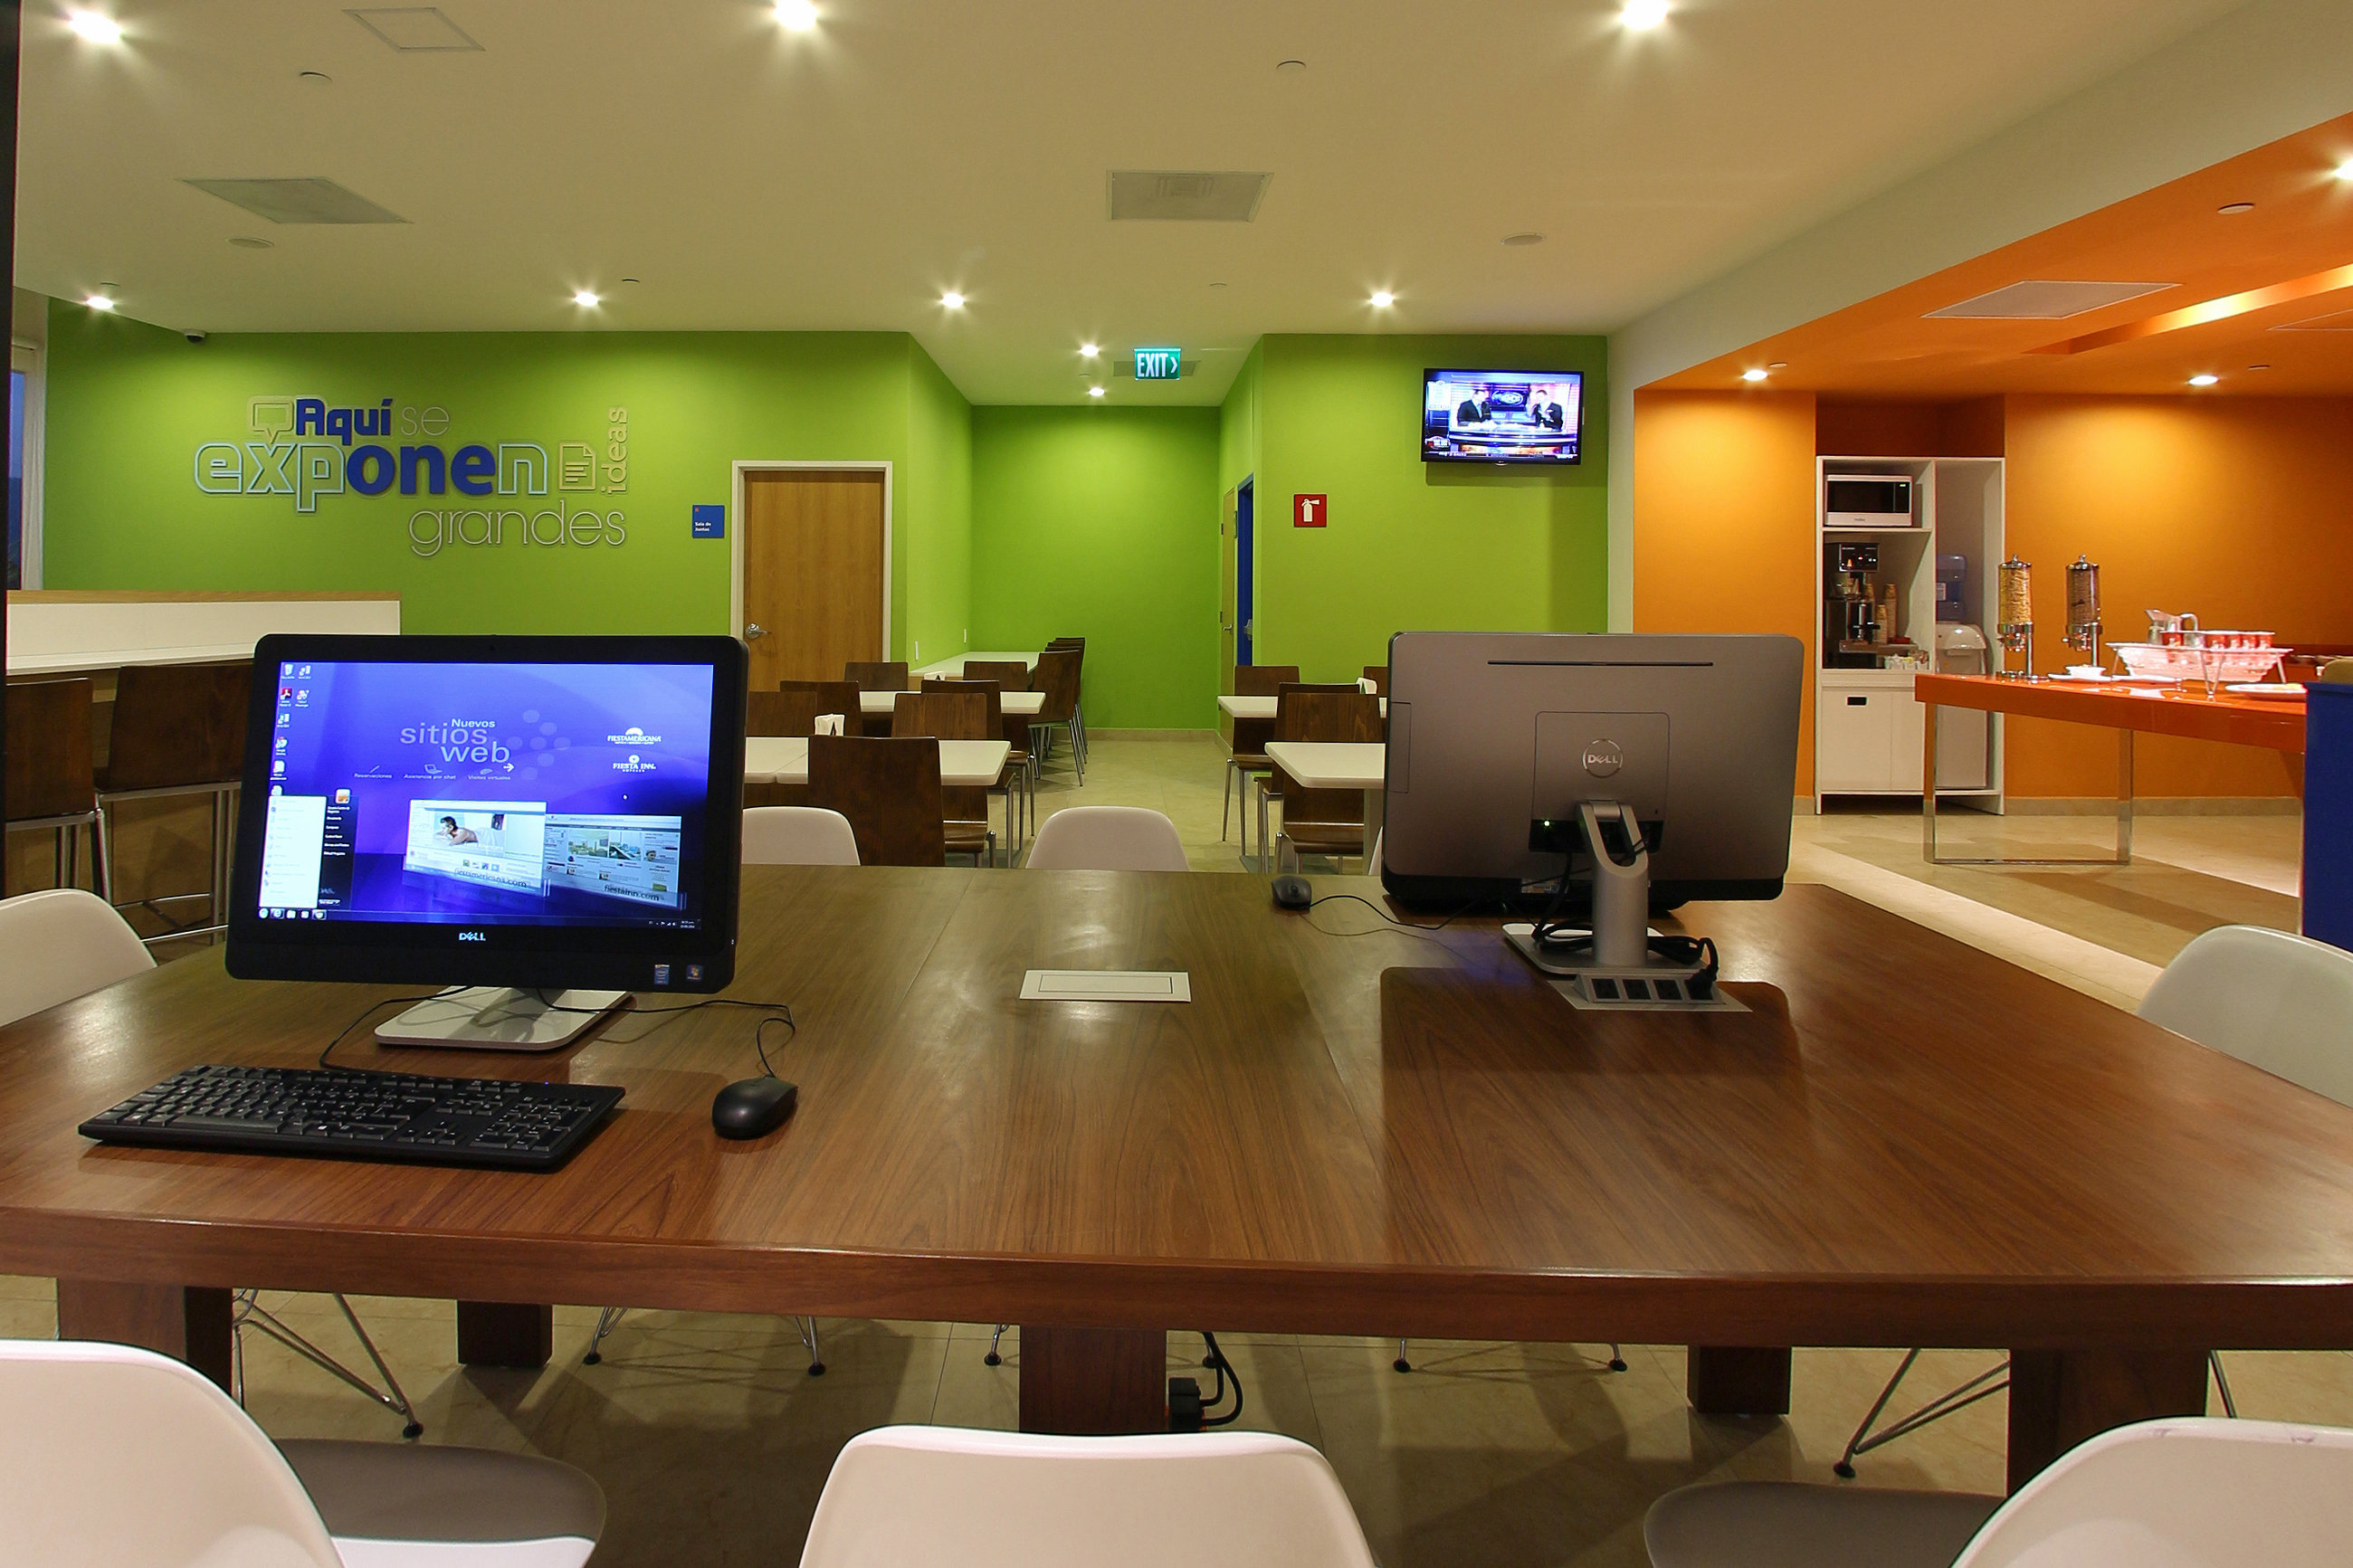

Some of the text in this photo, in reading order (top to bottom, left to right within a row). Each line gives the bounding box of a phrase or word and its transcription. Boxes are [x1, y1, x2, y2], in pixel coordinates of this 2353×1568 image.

[1137, 352, 1168, 377] EXIT
[295, 398, 450, 446] Aquí se
[601, 406, 627, 494] ideas
[194, 442, 548, 512] exponen
[409, 499, 626, 556] grandes
[400, 722, 488, 745] sitios
[451, 718, 496, 728] Nuevos
[440, 740, 510, 764] web
[1587, 754, 1619, 764] DELL
[604, 884, 660, 901] fiestainn.com
[458, 932, 486, 941] DELL
